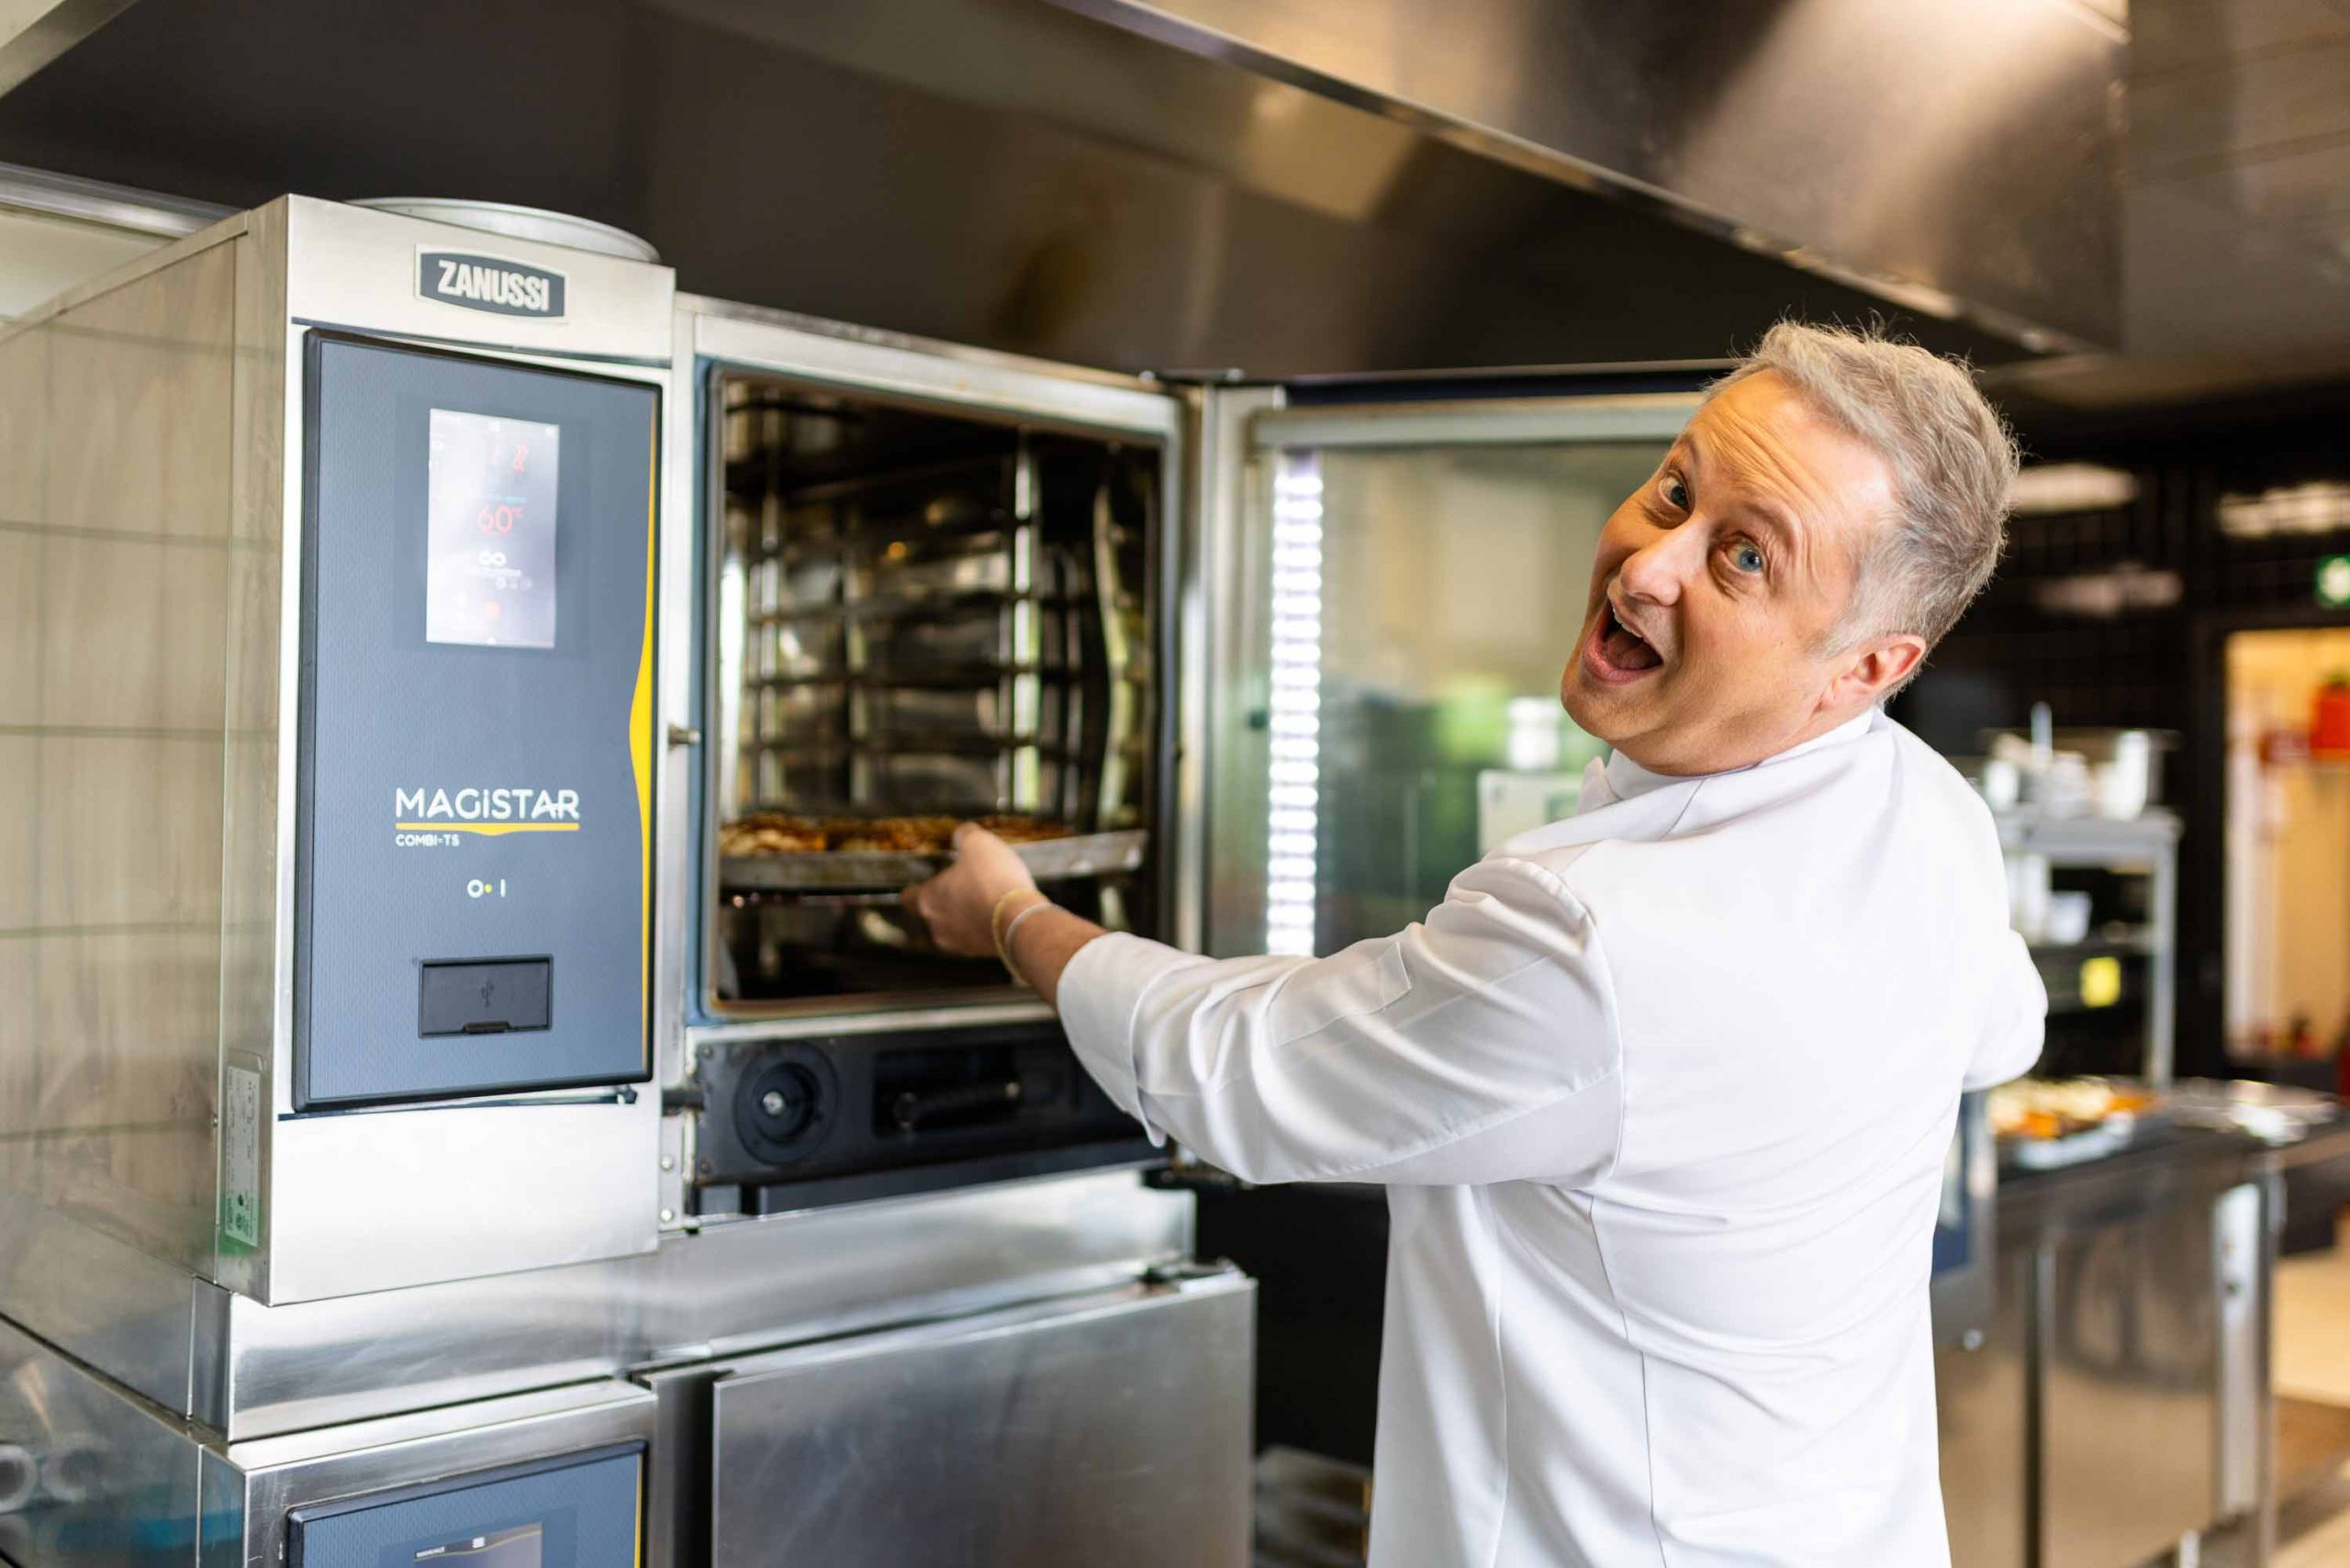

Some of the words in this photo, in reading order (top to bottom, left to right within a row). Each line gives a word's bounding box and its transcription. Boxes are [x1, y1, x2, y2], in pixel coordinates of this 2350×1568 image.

[437, 259, 551, 312] ZANUSSI
[395, 787, 581, 820] MAGISTAR
[395, 833, 461, 847] COMBI-TS
